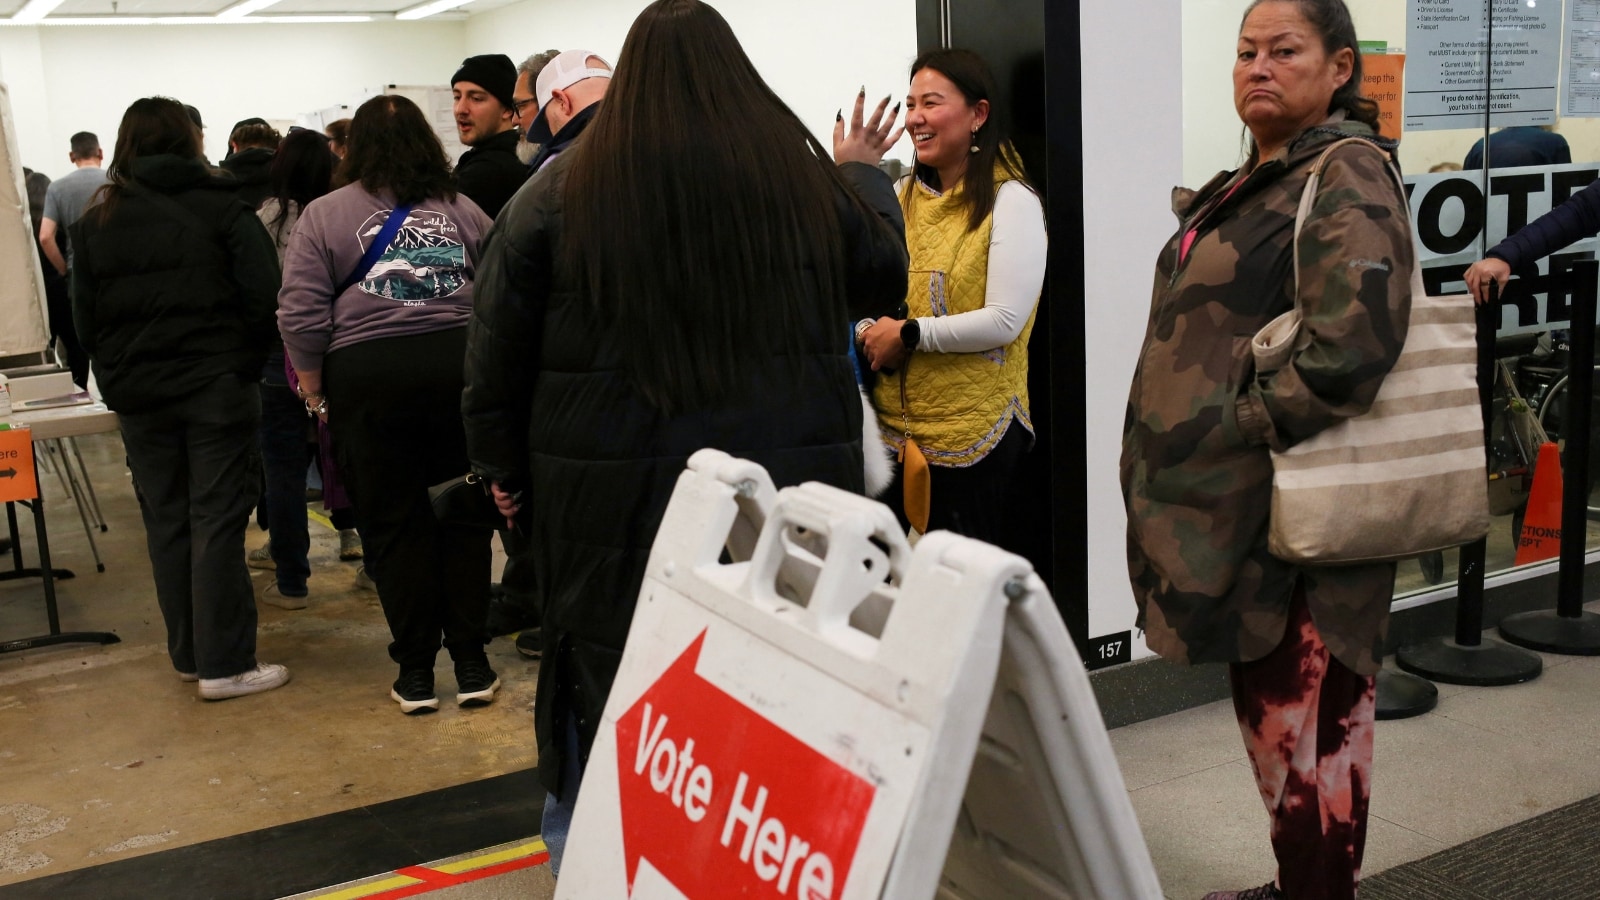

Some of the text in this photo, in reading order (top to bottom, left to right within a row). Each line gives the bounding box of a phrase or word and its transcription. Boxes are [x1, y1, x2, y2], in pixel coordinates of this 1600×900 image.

[1364, 73, 1394, 85] keep the
[1387, 91, 1396, 101] for
[1449, 104, 1461, 112] your
[1406, 169, 1599, 254] OTE
[423, 217, 440, 226] wild
[440, 224, 456, 234] free
[0, 450, 18, 459] ere
[1521, 525, 1561, 539] CTIONS
[1098, 641, 1122, 659] 157
[634, 702, 834, 900] Vote Here
